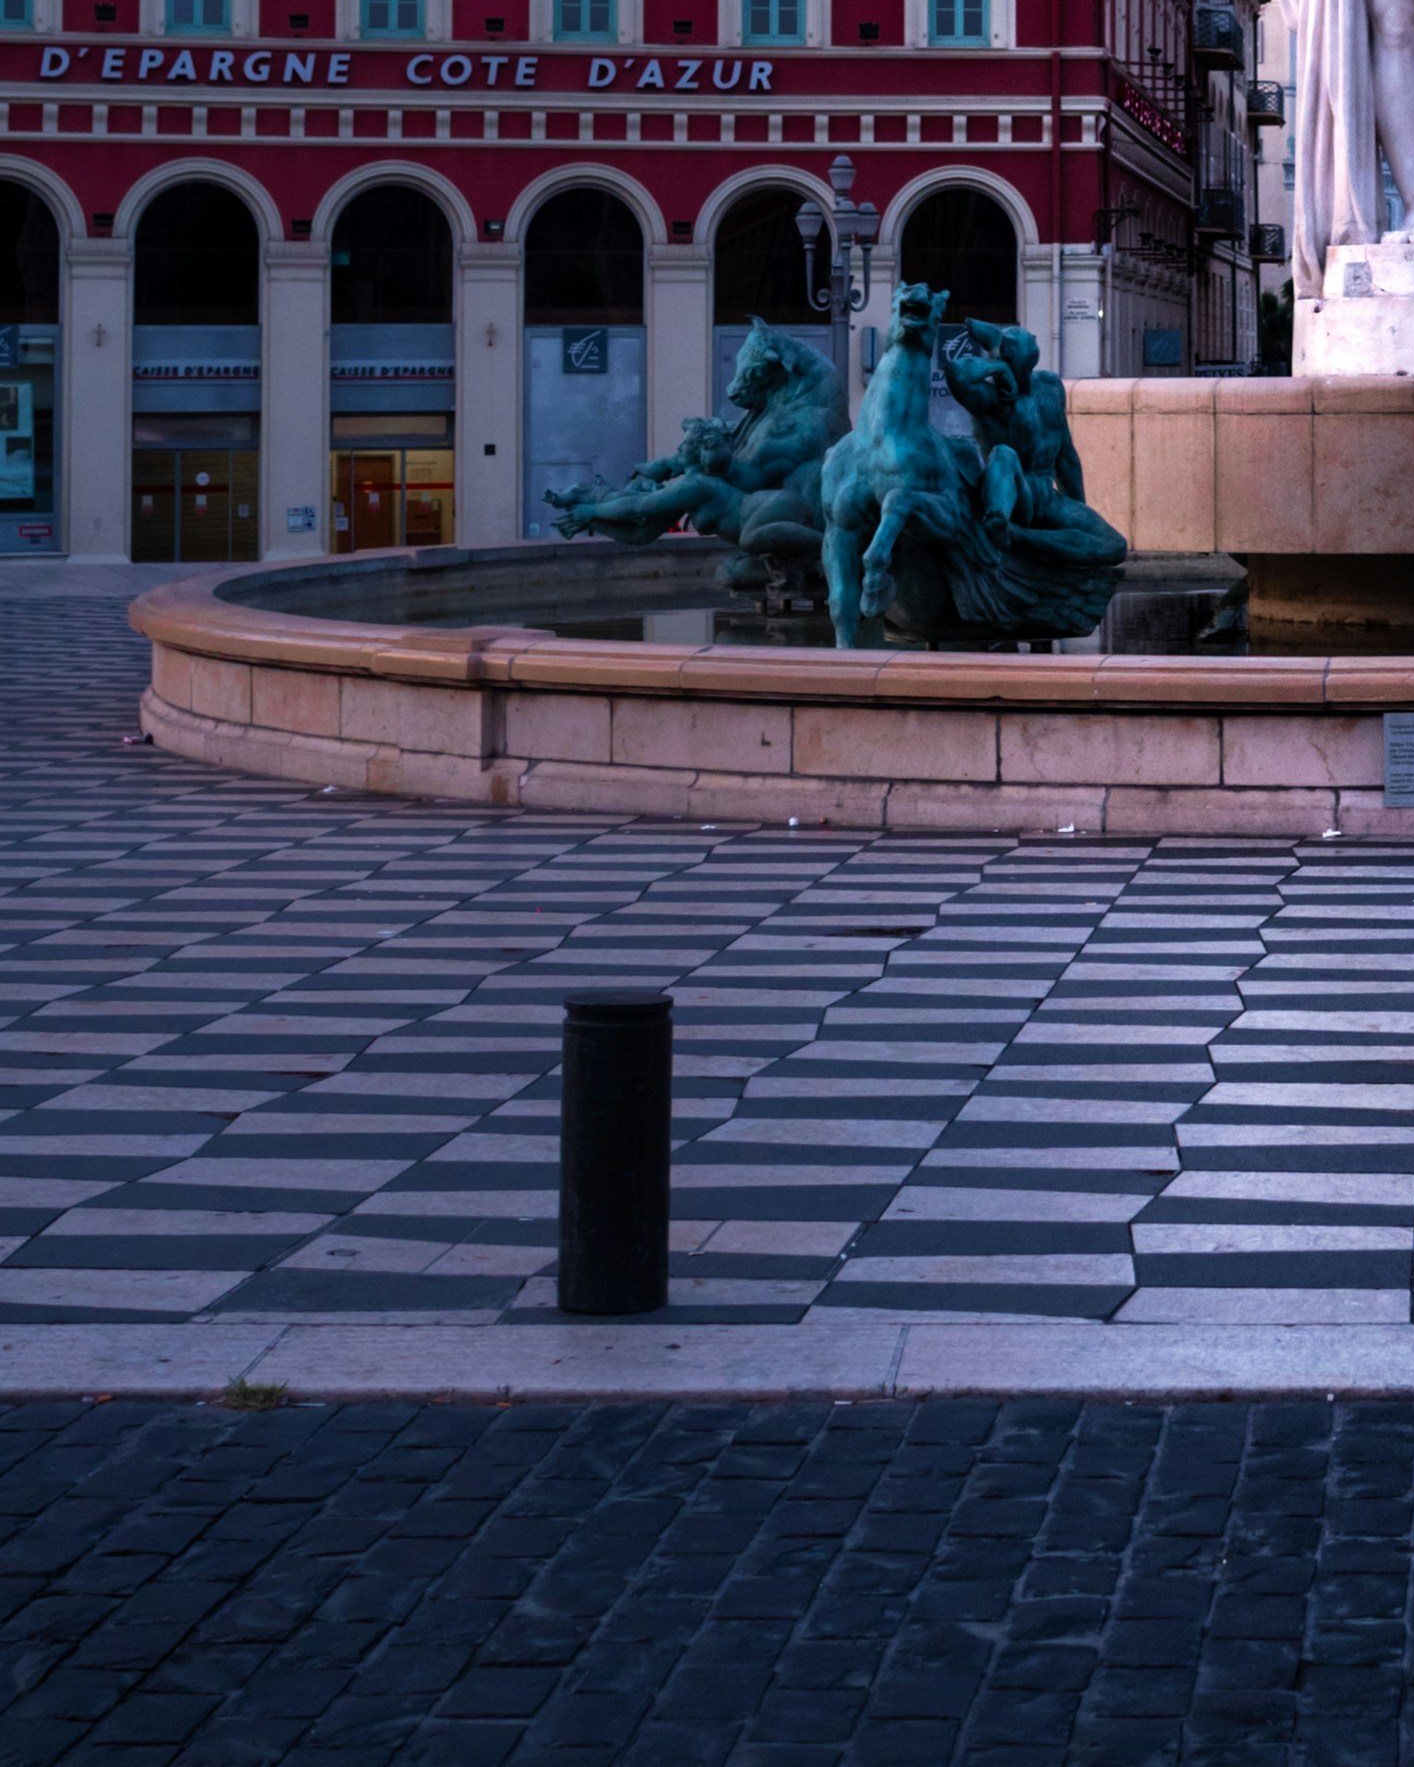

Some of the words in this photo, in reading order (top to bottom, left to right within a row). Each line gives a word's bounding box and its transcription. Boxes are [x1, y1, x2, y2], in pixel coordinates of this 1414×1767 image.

[40, 46, 351, 83] D'EPARGNE
[406, 54, 538, 86] COTE
[588, 58, 773, 90] D'AZUR
[132, 365, 179, 377] CAISSE
[184, 365, 261, 377] D'EPARGNE
[330, 365, 376, 377] CAISSE
[380, 365, 455, 377] D'EPARGNE
